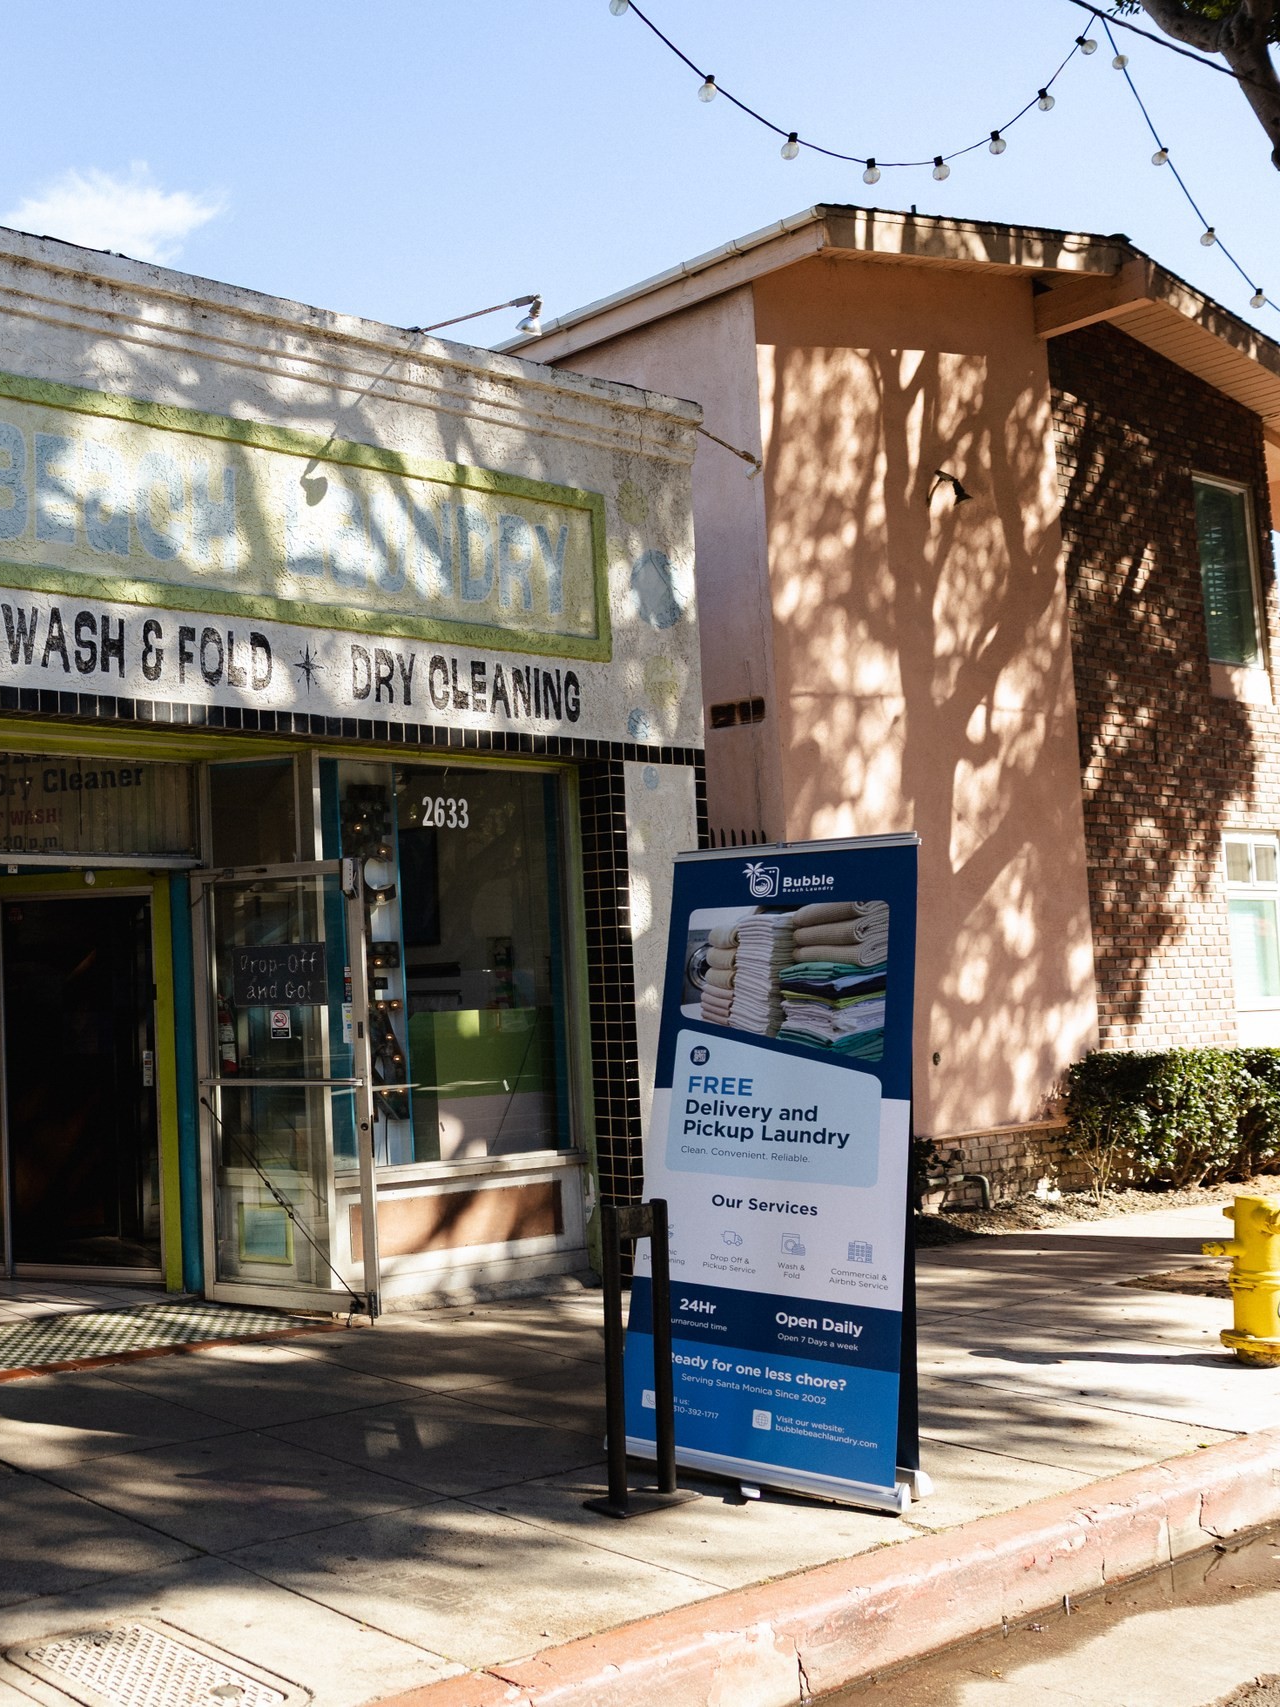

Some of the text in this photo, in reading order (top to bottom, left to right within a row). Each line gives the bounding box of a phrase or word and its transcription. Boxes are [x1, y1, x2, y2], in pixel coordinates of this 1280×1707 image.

[285, 470, 568, 615] LAUNDRY
[1, 603, 273, 692] WASH & FOLD
[350, 643, 581, 724] DRY CLEANING
[42, 766, 144, 793] Cleaner
[422, 796, 470, 829] 2633
[782, 874, 835, 888] Bubble
[805, 885, 835, 893] Laundry
[285, 980, 312, 1000] Go!
[688, 1075, 754, 1097] FREE
[685, 1098, 818, 1123] Delivery and
[683, 1119, 850, 1149] Pickup Laundry
[680, 1145, 811, 1164] Clean. Convenient. Reliable.
[711, 1194, 818, 1217] Our Services
[702, 1262, 756, 1274] Pickup Service
[710, 1253, 729, 1263] Drop
[730, 1256, 743, 1264] Off
[777, 1262, 798, 1270] Wash
[783, 1271, 801, 1280] Fold
[829, 1277, 889, 1291] Airbnb Service
[830, 1268, 880, 1280] Commercial
[679, 1298, 717, 1314] 24Hr
[670, 1318, 728, 1332] urnaround time
[775, 1311, 863, 1338] Open Daily
[777, 1332, 799, 1342] Open
[807, 1337, 828, 1347] Days
[837, 1343, 859, 1351] week
[712, 1358, 732, 1372] for
[736, 1365, 761, 1377] one
[765, 1366, 792, 1382] less
[795, 1373, 847, 1391] chore?
[681, 1373, 827, 1405] Serving Santa Monica Since 2002
[775, 1414, 793, 1424] Visit
[811, 1421, 845, 1433] website:
[775, 1423, 878, 1448] bubblebeachlaundry.com
